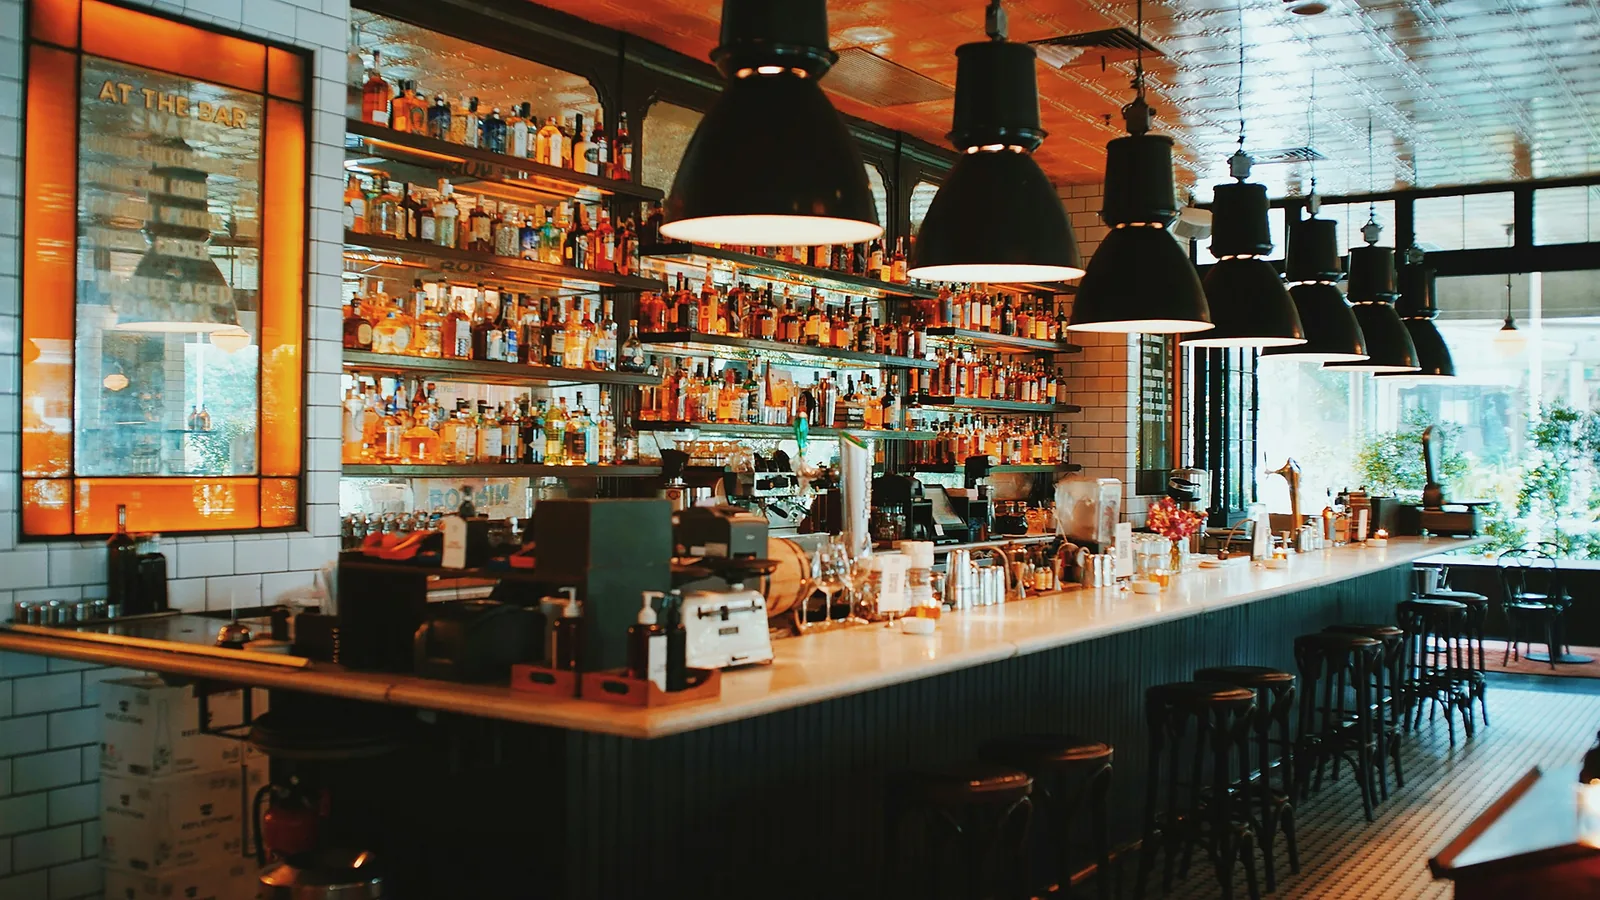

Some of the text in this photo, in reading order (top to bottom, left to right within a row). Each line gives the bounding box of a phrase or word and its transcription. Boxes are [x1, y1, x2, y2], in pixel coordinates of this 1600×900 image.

[99, 80, 248, 129] AT THE BAR
